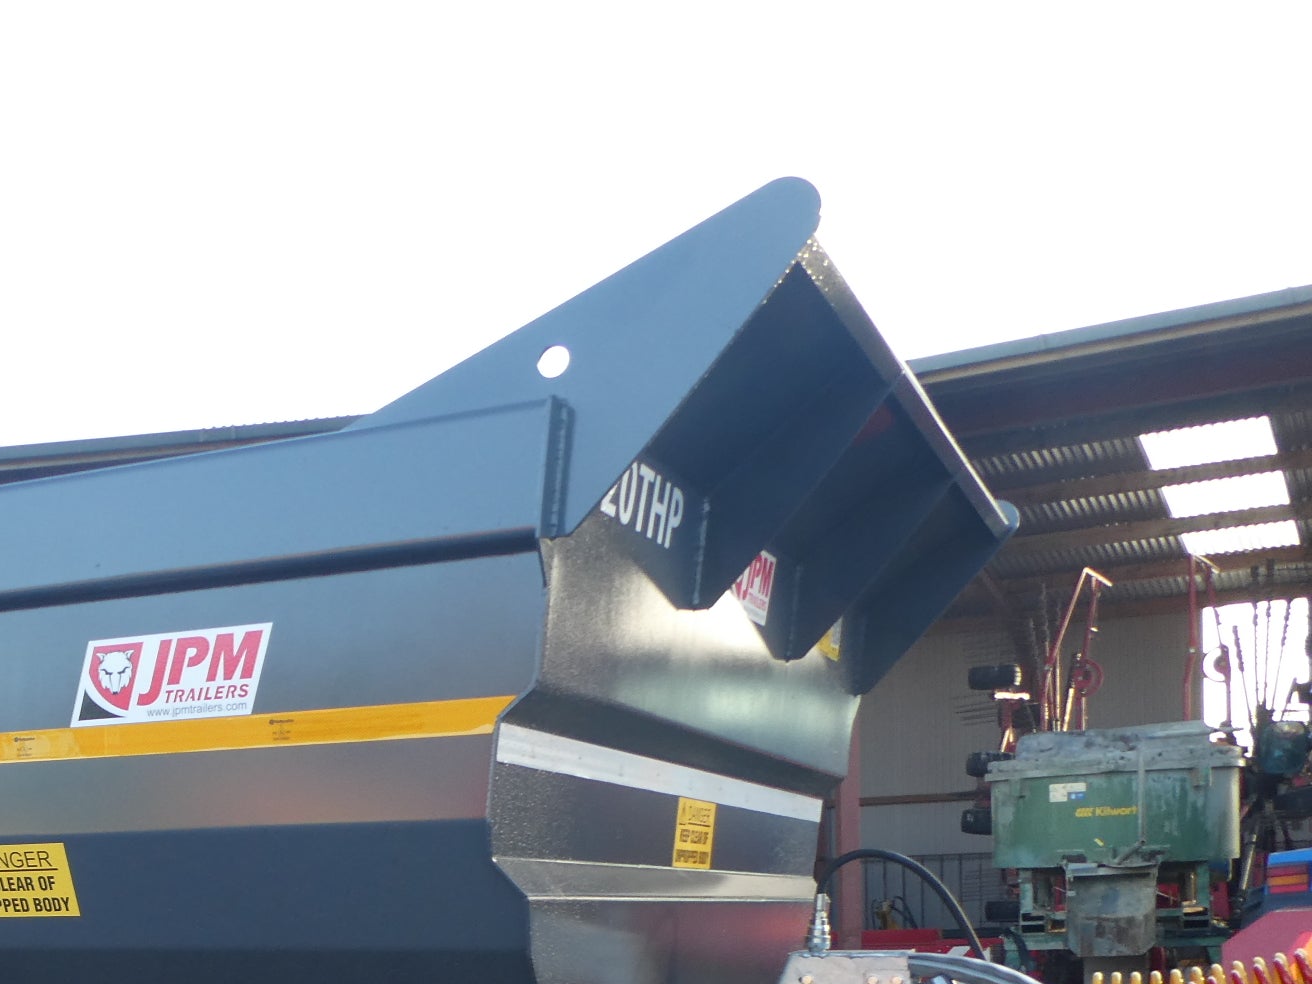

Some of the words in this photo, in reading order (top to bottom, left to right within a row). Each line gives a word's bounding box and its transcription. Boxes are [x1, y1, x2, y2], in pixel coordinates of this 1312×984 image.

[136, 630, 264, 706] JPM
[165, 683, 250, 704] TRAILERS
[146, 701, 248, 719] www.jpmtrailers.com
[1095, 805, 1138, 817] Kilwort
[38, 876, 56, 891] OF
[33, 897, 70, 912] BODY
